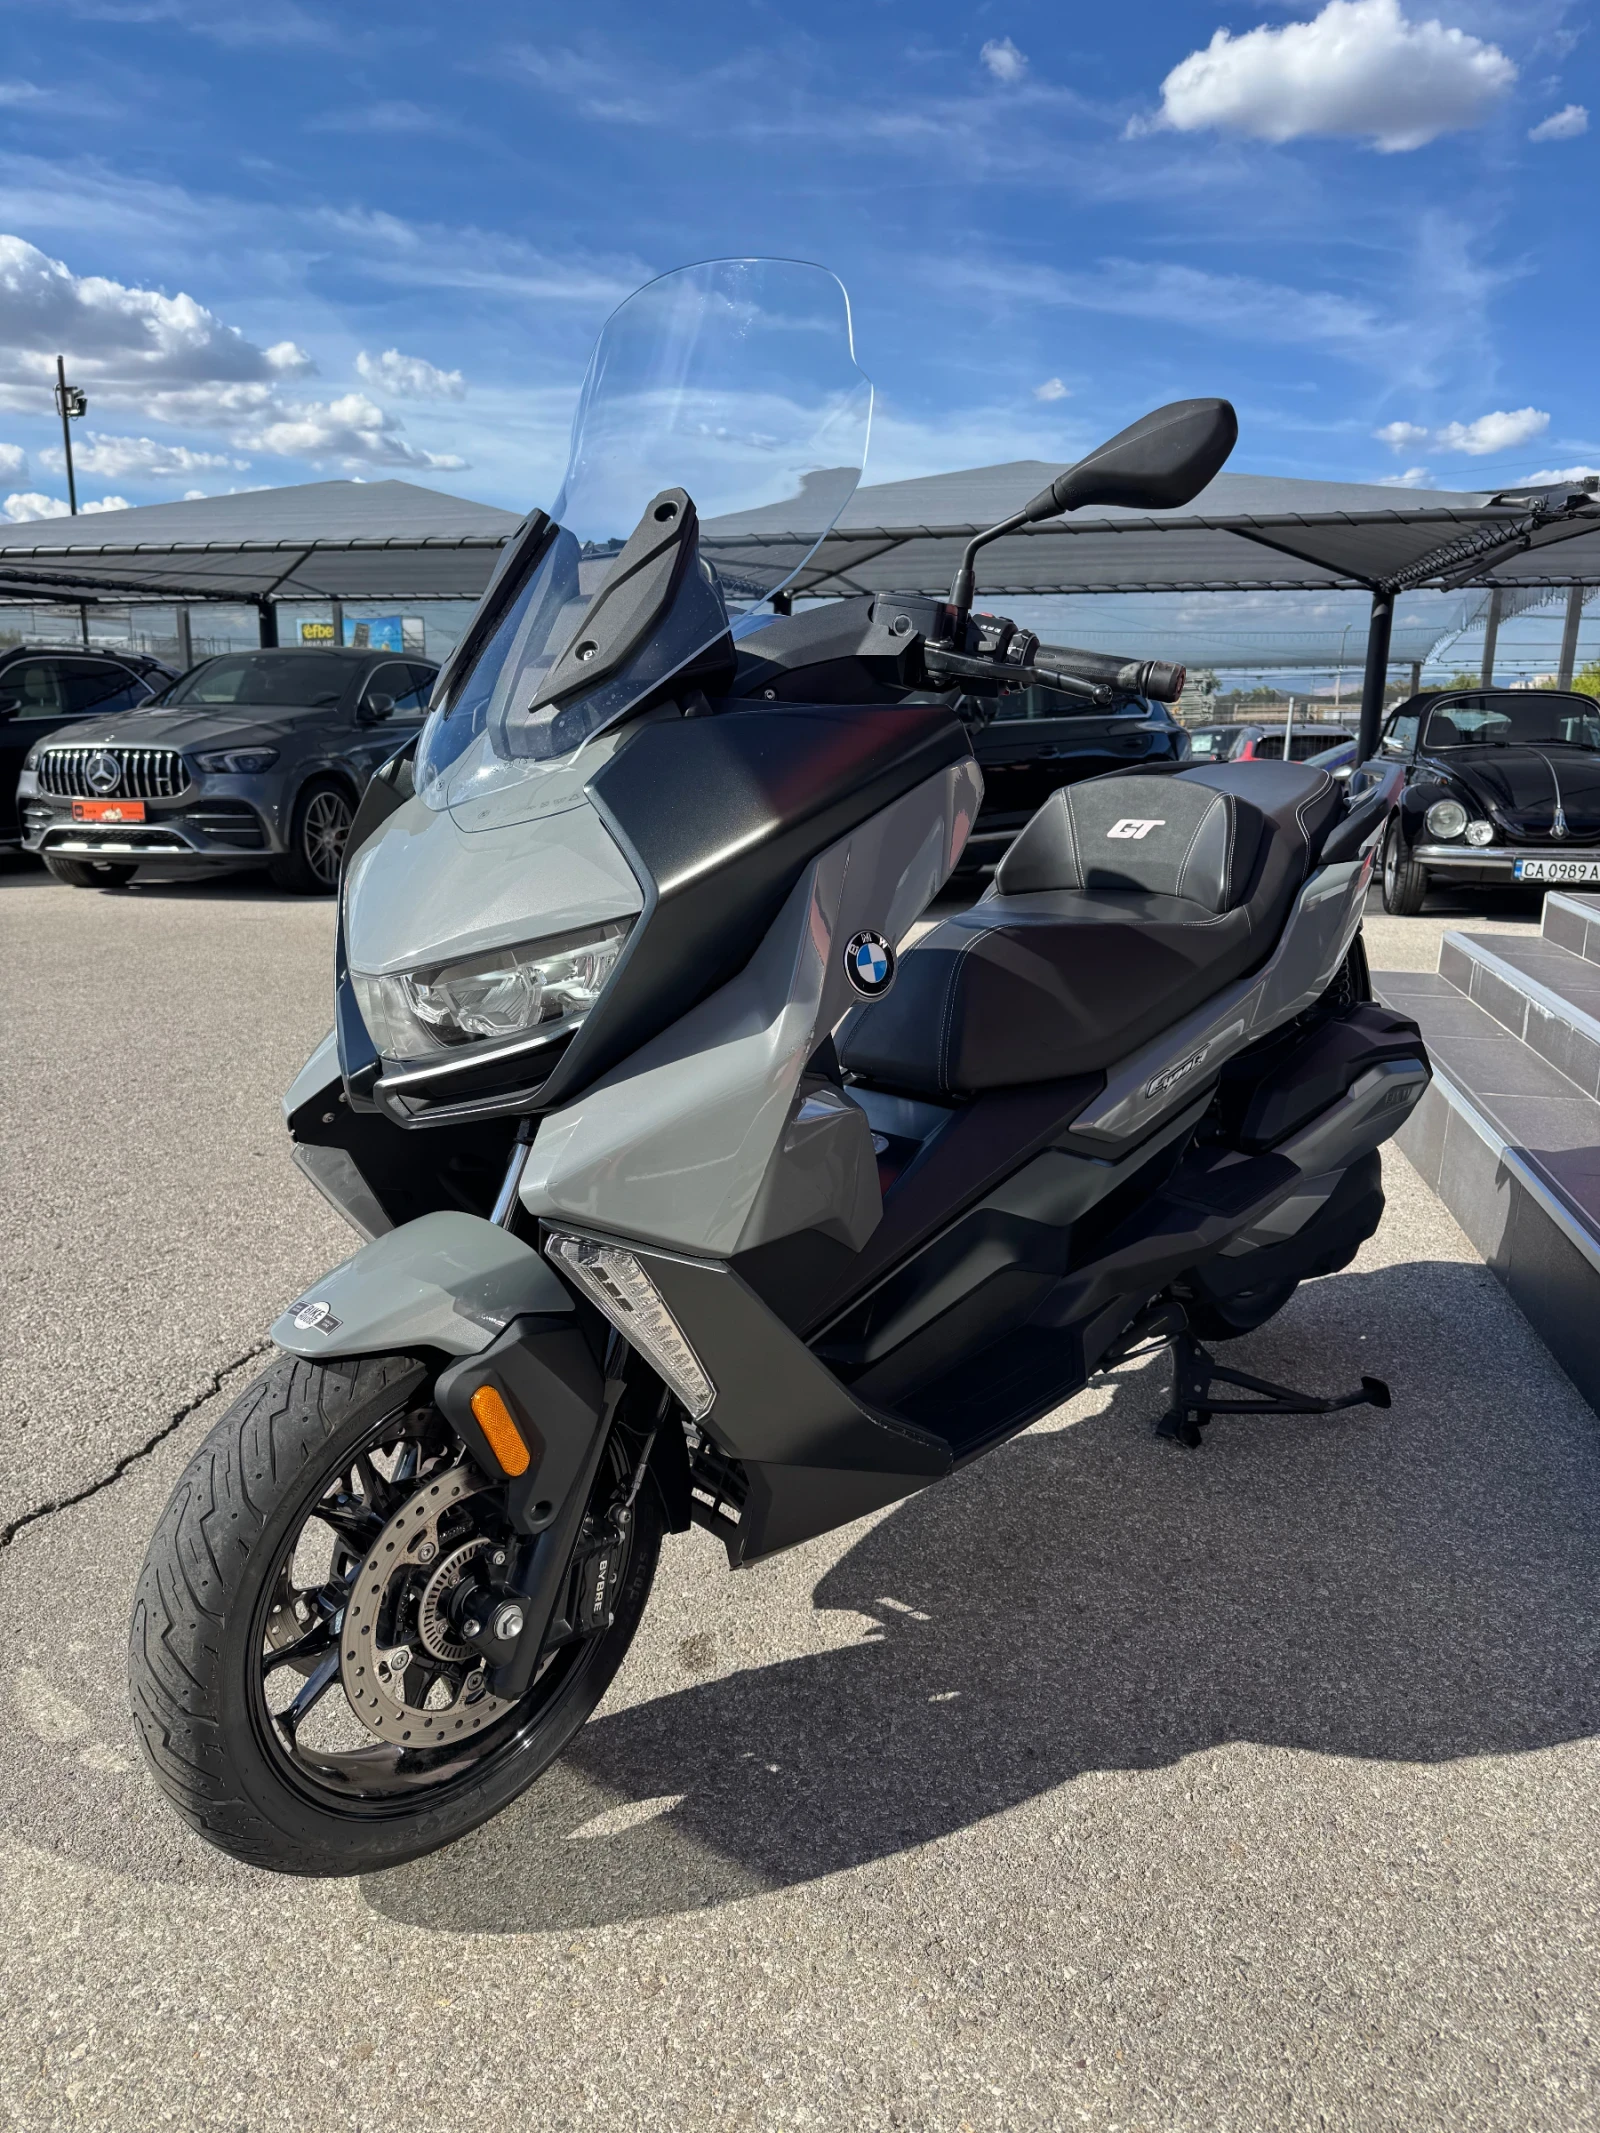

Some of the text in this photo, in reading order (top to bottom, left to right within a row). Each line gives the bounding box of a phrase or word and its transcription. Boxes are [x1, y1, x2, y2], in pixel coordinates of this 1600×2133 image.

[303, 624, 334, 639] efbe
[1106, 818, 1166, 840] GT
[1525, 862, 1544, 878] CA
[1548, 863, 1587, 879] 0989
[1589, 864, 1599, 879] A
[848, 932, 888, 956] BMW
[303, 1305, 326, 1320] BIKE
[593, 1559, 608, 1612] BYBRE
